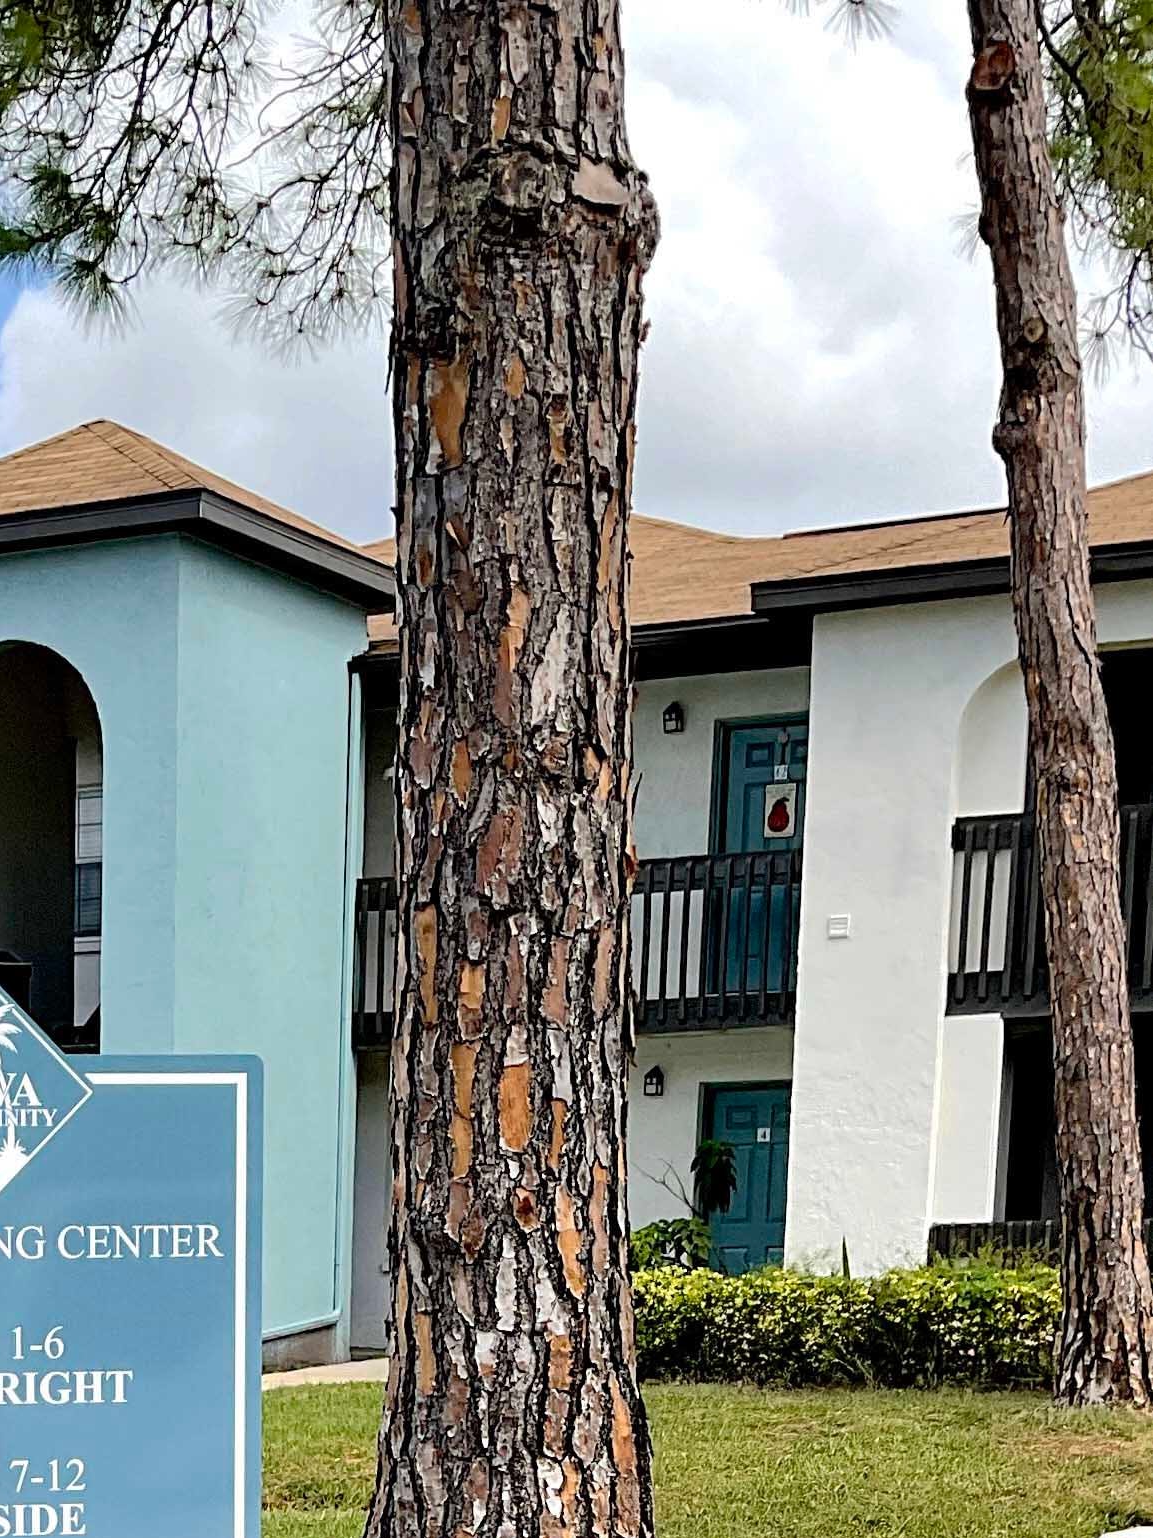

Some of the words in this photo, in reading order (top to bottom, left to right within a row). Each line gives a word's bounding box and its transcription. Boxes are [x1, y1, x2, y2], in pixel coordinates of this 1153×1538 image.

[57, 1224, 225, 1260] CENTER
[11, 1326, 65, 1360] 1-6
[9, 1458, 87, 1493] 7-12
